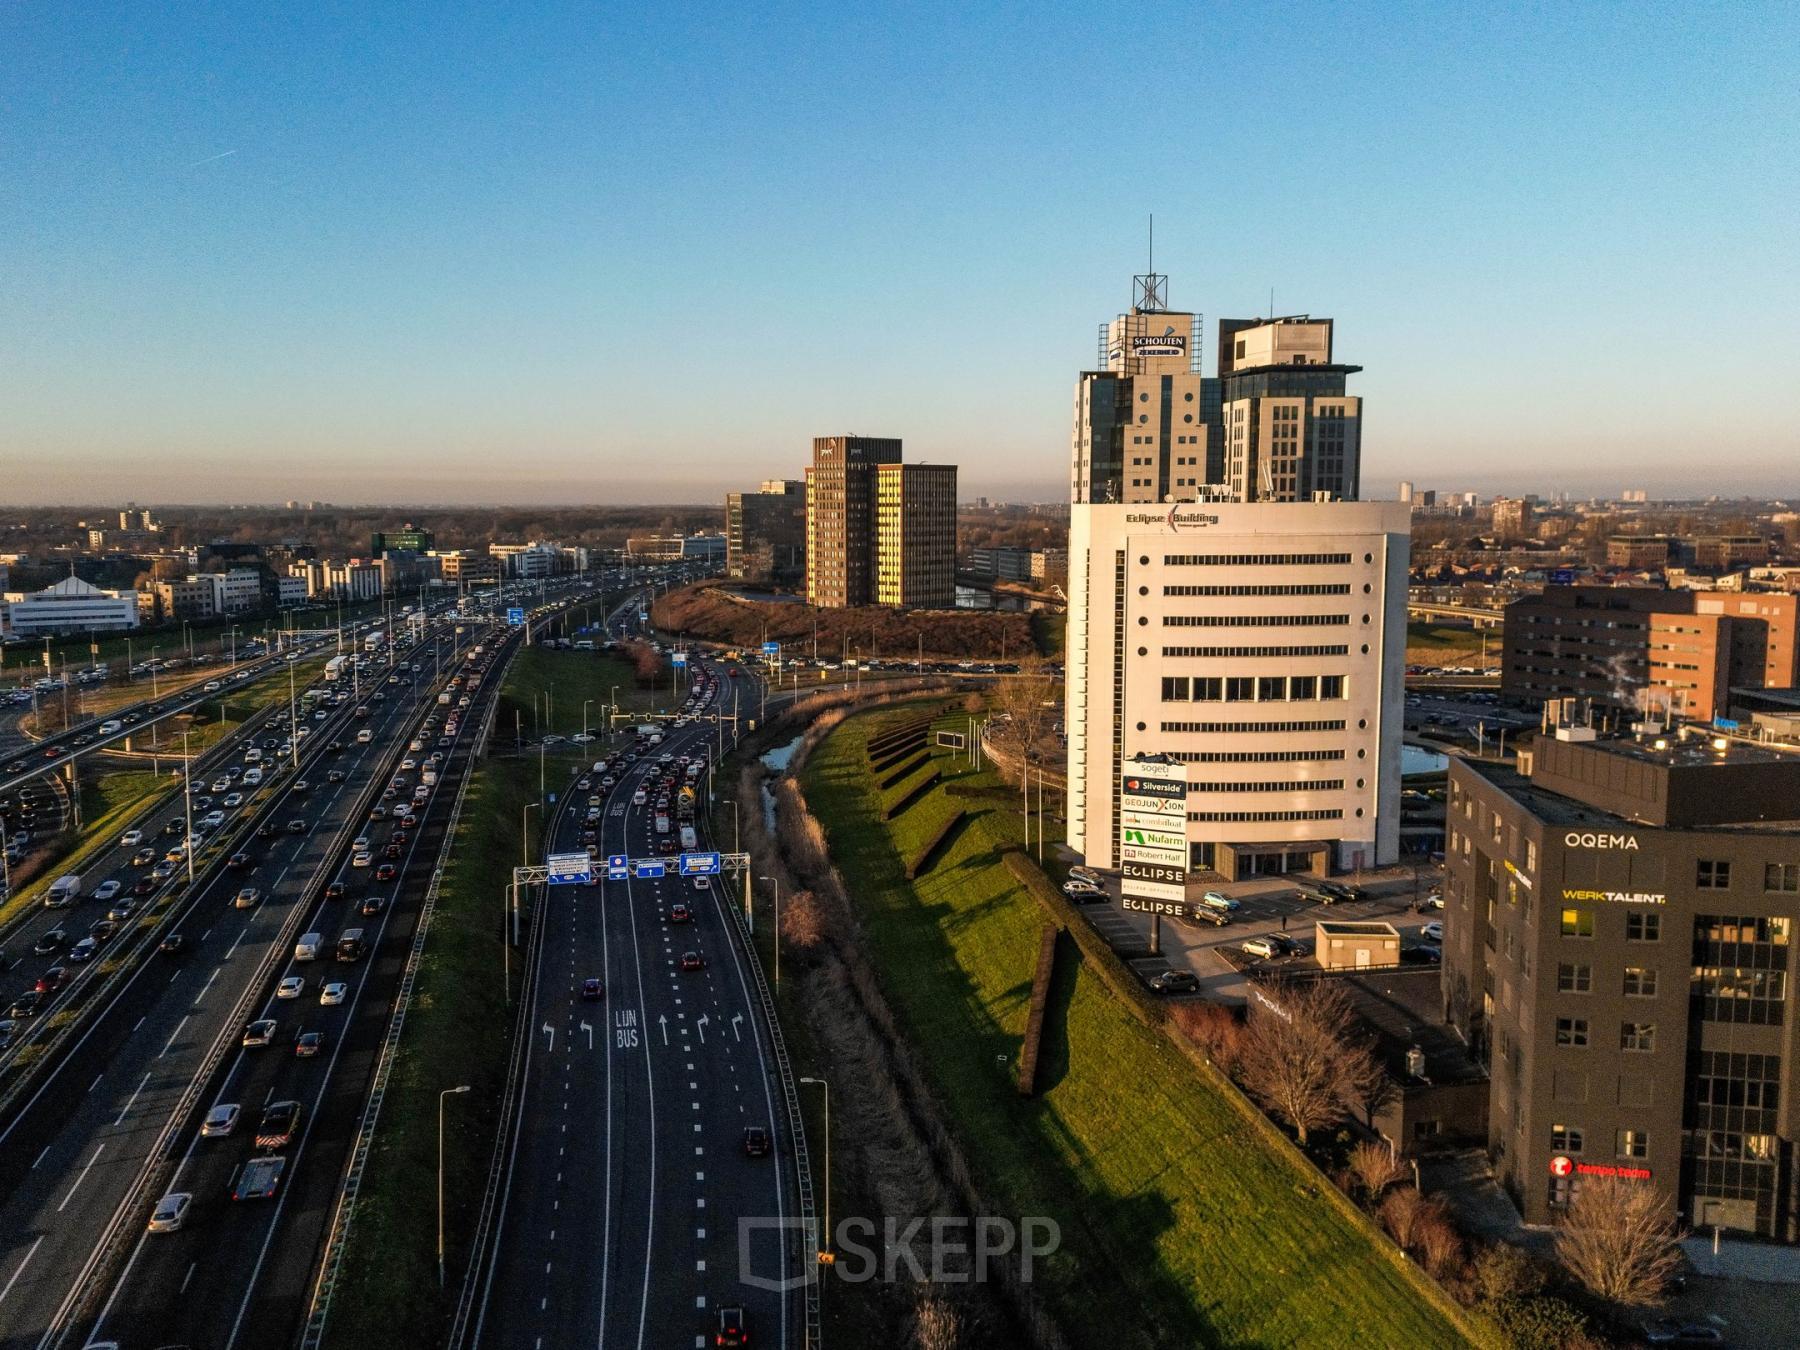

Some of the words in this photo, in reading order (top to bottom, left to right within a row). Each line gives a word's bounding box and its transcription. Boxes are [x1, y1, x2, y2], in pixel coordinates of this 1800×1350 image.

[1134, 337, 1183, 345] SCHOUTEN
[1126, 513, 1165, 525] Eclipse
[1172, 513, 1219, 525] Building
[1141, 764, 1169, 774] sogeti
[1142, 781, 1182, 793] Silverside
[1125, 798, 1184, 812] GEOJUNXION
[1147, 833, 1183, 845] Nufarm
[1564, 833, 1639, 850] OQEMA
[1137, 850, 1163, 860] Robert
[1165, 853, 1181, 862] Half
[1123, 865, 1183, 881] ECLIPSE
[1122, 898, 1183, 916] ECLIPSE
[616, 1029, 638, 1048] BUS
[1577, 1163, 1616, 1176] tempo
[1618, 1167, 1650, 1179] team
